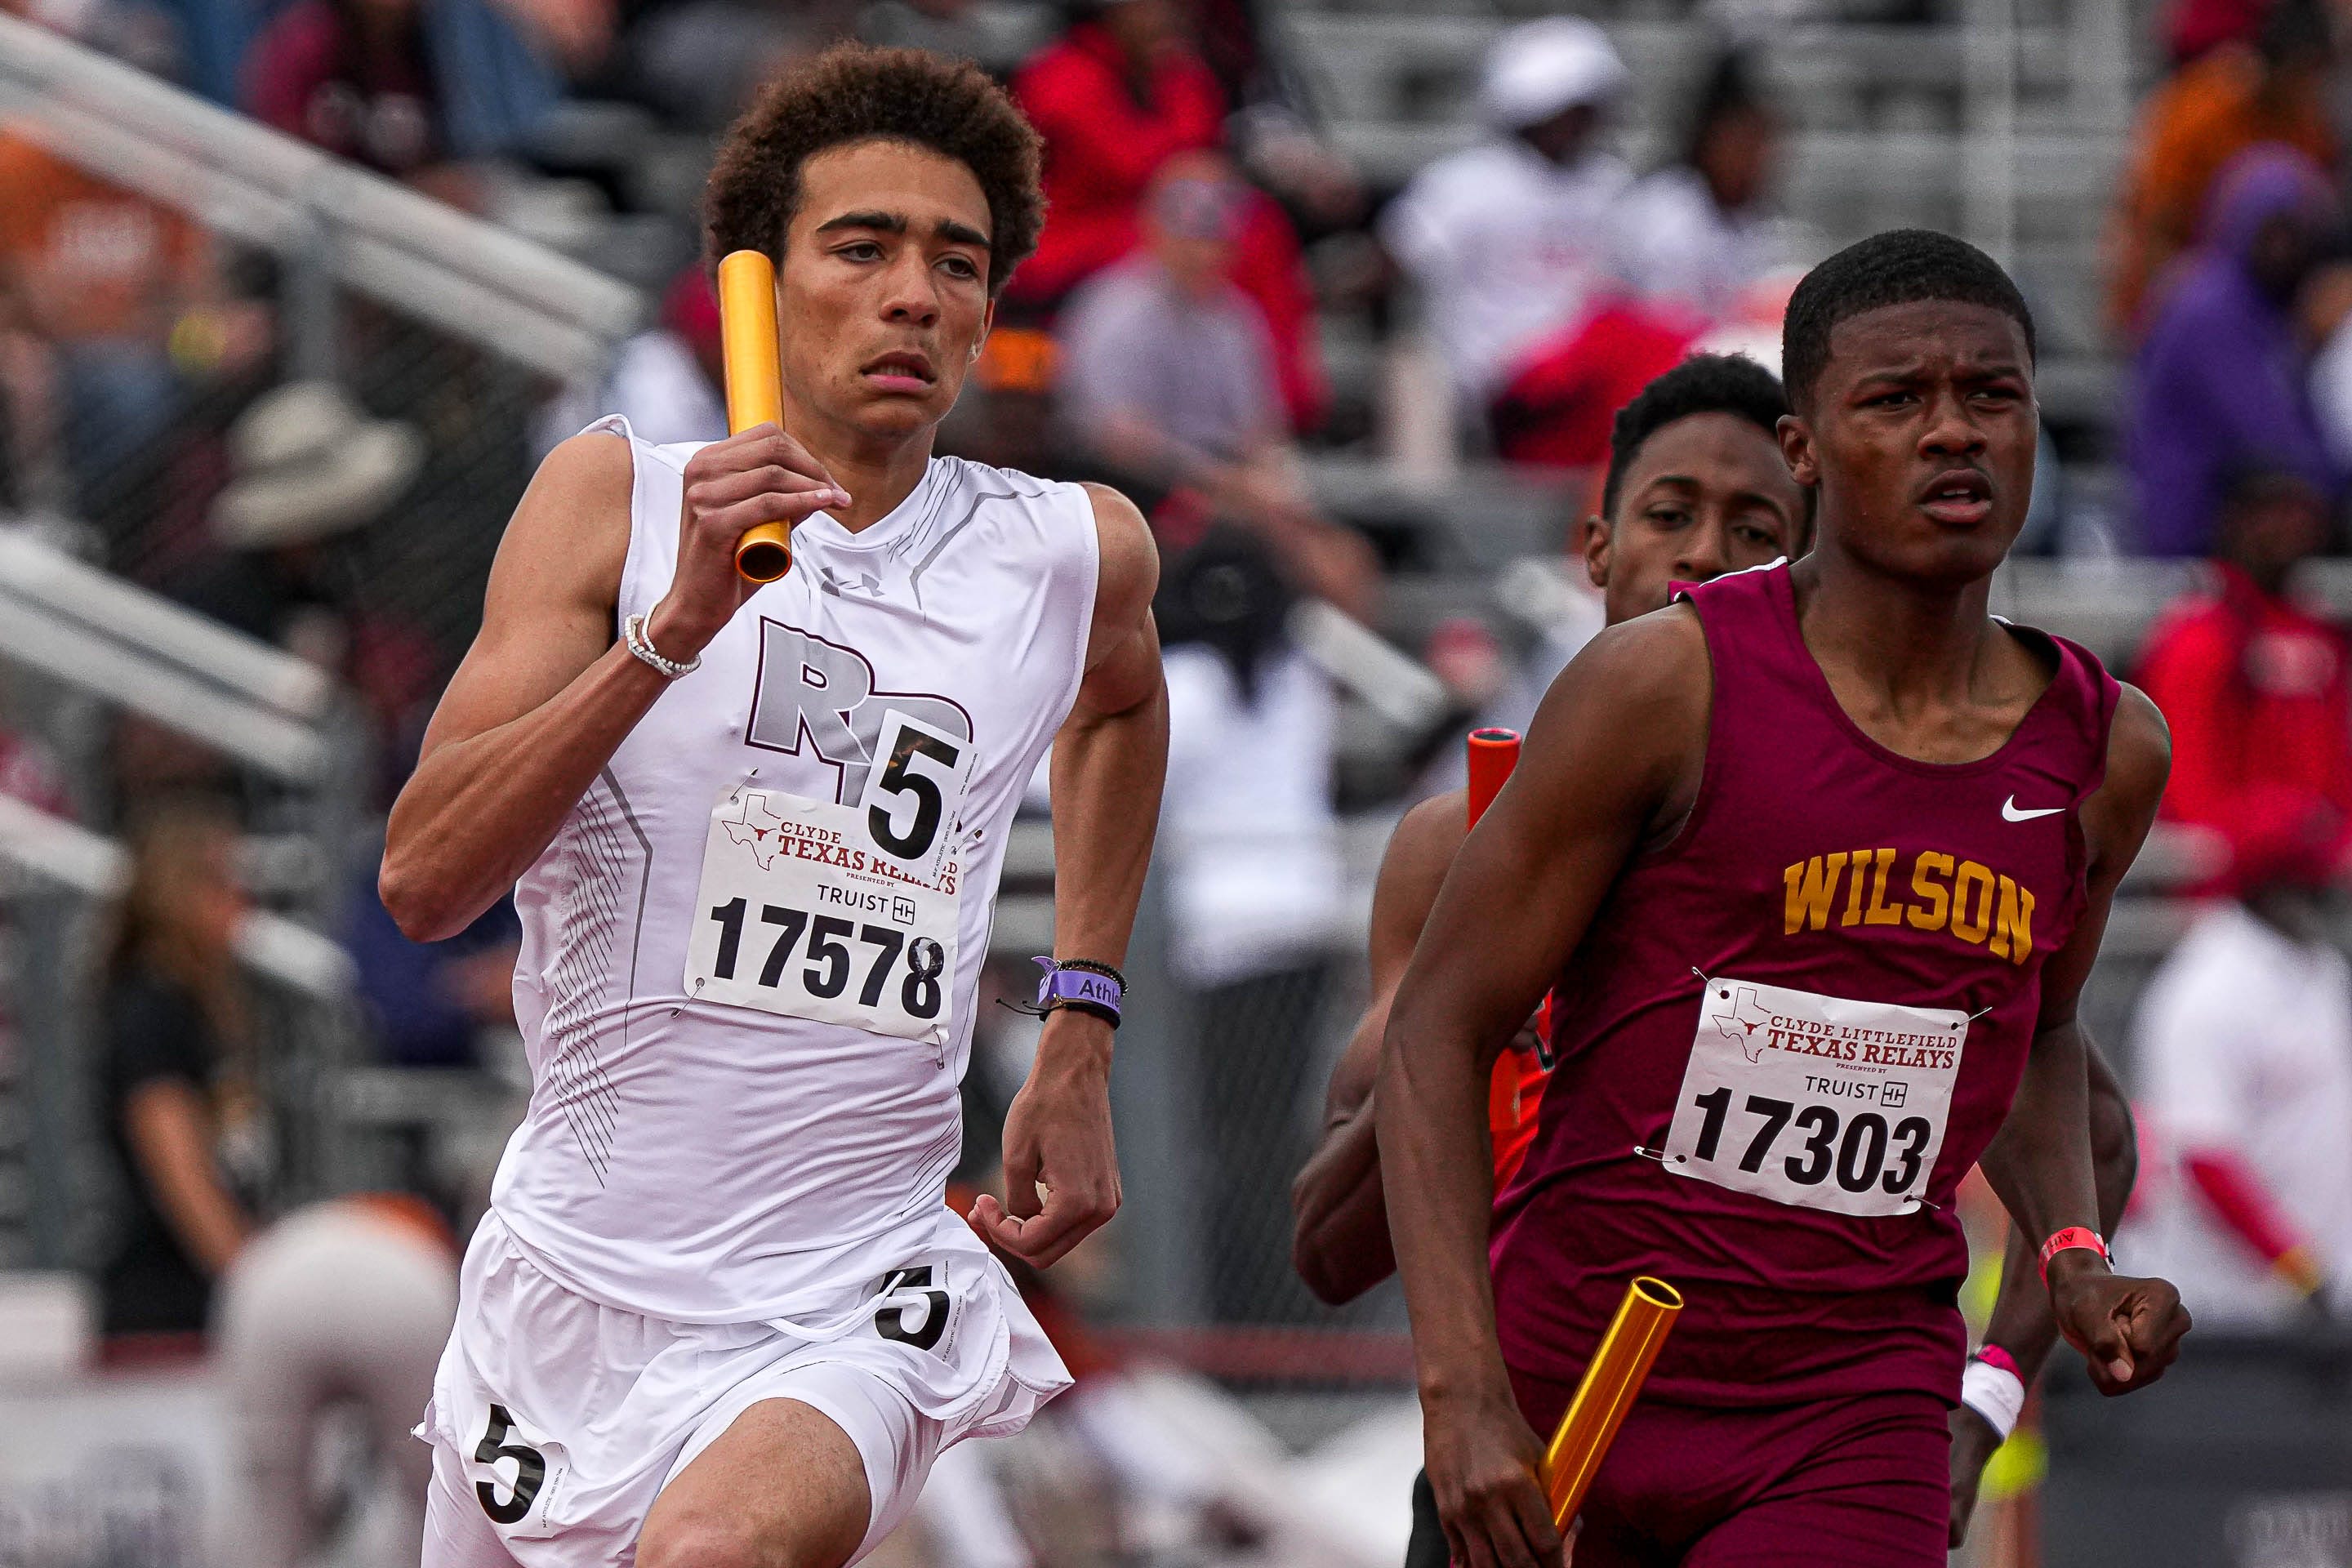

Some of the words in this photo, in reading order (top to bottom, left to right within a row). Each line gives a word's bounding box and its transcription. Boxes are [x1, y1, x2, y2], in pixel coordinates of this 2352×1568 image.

[869, 724, 960, 860] 5
[781, 822, 841, 844] CLYDE
[777, 835, 866, 871] TEXAS
[846, 872, 885, 885] PRESENTED
[817, 884, 889, 912] TRUIST
[1784, 849, 2034, 965] WILSON
[710, 897, 945, 1019] 17578
[1767, 1028, 1858, 1062] TEXAS
[1862, 1044, 1955, 1069] RELAYS
[1771, 1015, 1835, 1036] CLYDE
[1841, 1027, 1958, 1049] LITTLEFIELD
[1836, 1062, 1877, 1073] PRESENTED
[1806, 1076, 1878, 1100] TRUIST
[1695, 1086, 1931, 1195] 17303
[874, 1265, 951, 1352] 5
[474, 1403, 546, 1524] 5
